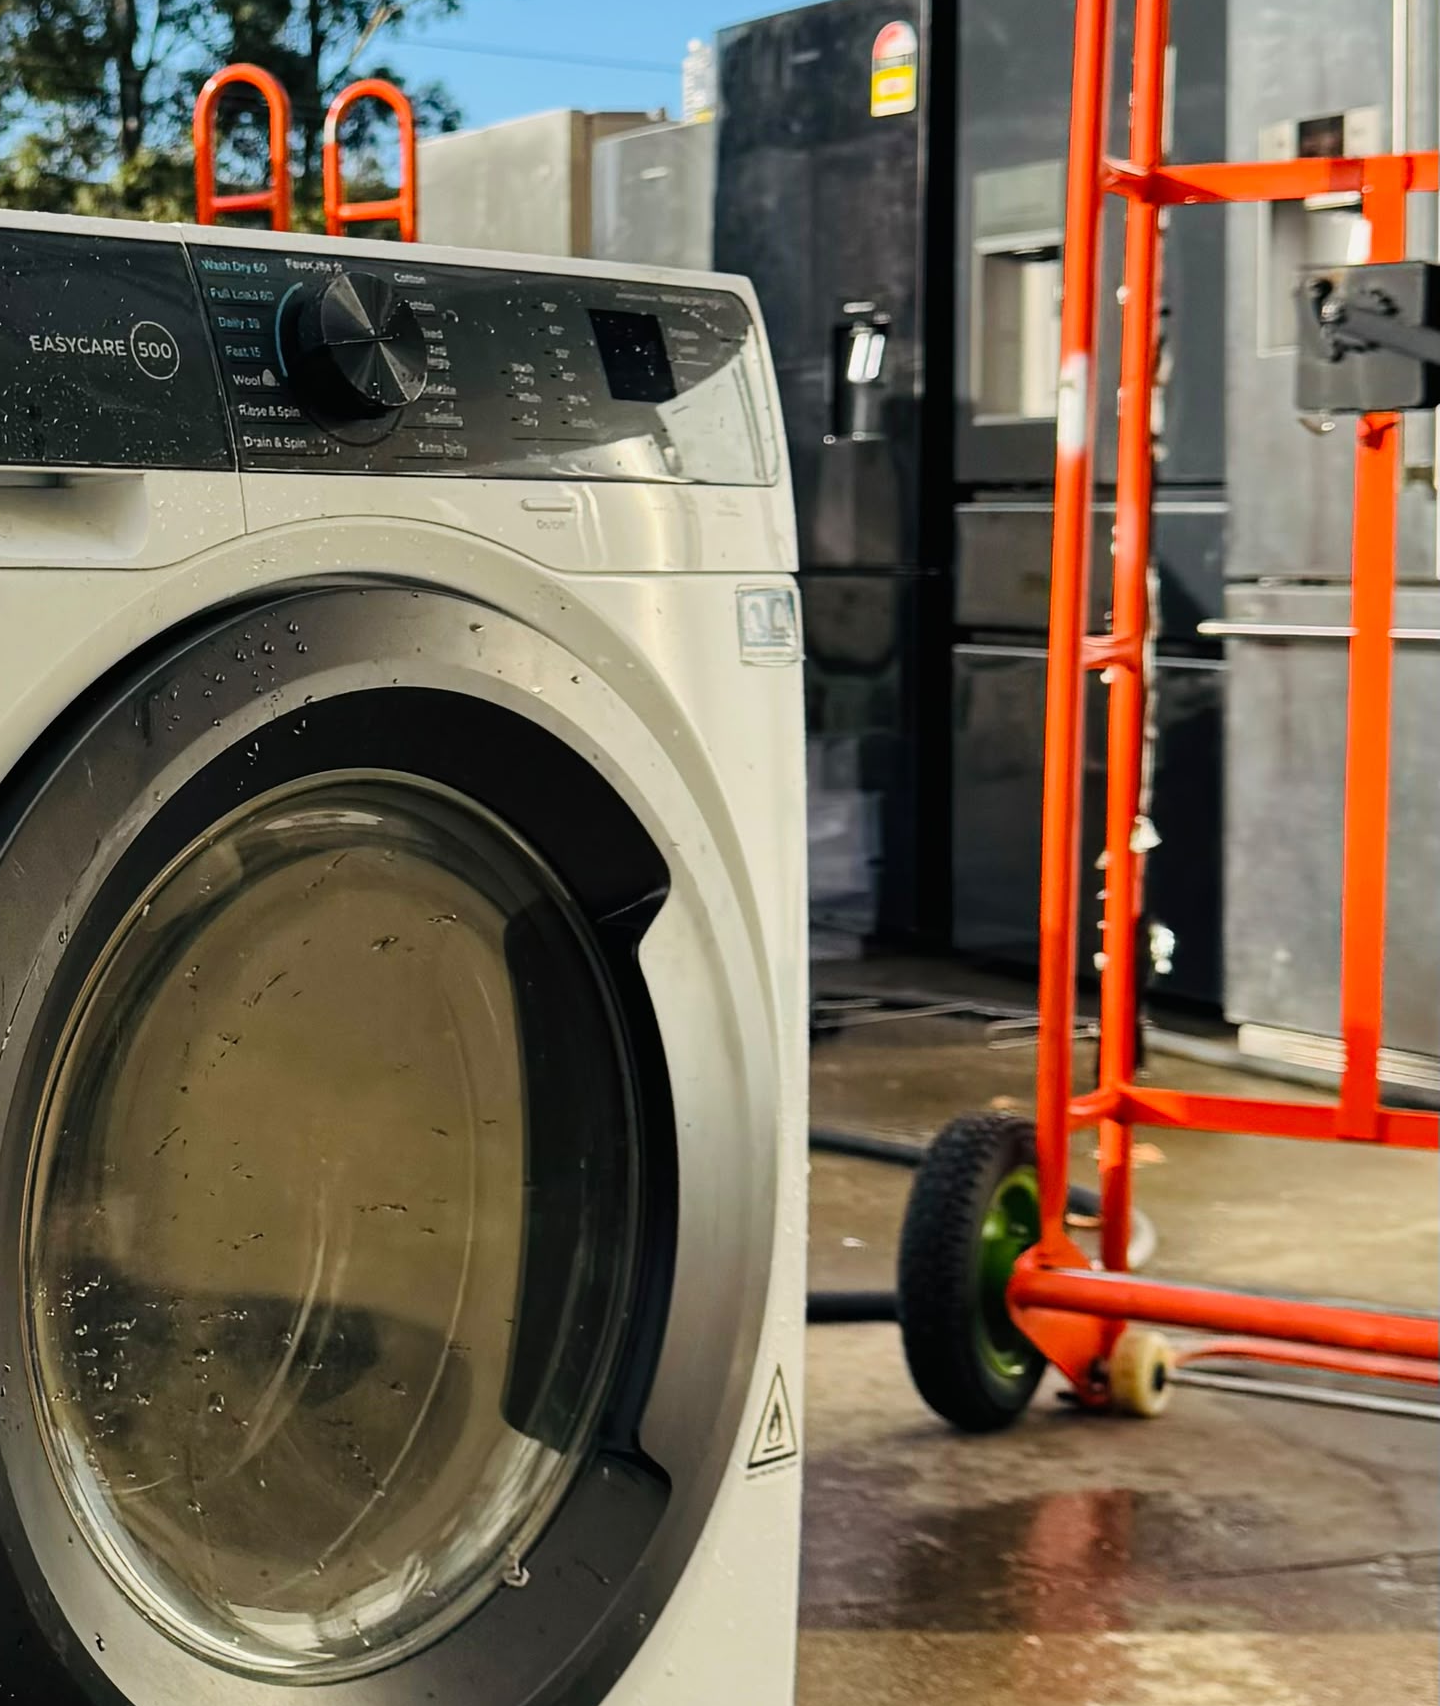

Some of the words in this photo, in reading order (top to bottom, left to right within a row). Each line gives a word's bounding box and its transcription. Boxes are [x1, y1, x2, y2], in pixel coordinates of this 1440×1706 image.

[201, 259, 231, 271] Wash
[232, 261, 251, 274] Dry
[218, 316, 244, 329] Daily
[29, 334, 127, 357] EASYCARE
[138, 341, 172, 359] 500
[225, 345, 249, 357] Fast
[250, 346, 261, 358] 15
[232, 373, 260, 386] Wool
[268, 405, 276, 417] &
[277, 406, 301, 419] Spin
[243, 435, 272, 448] Drain
[274, 436, 282, 448] &
[284, 437, 307, 450] Spin
